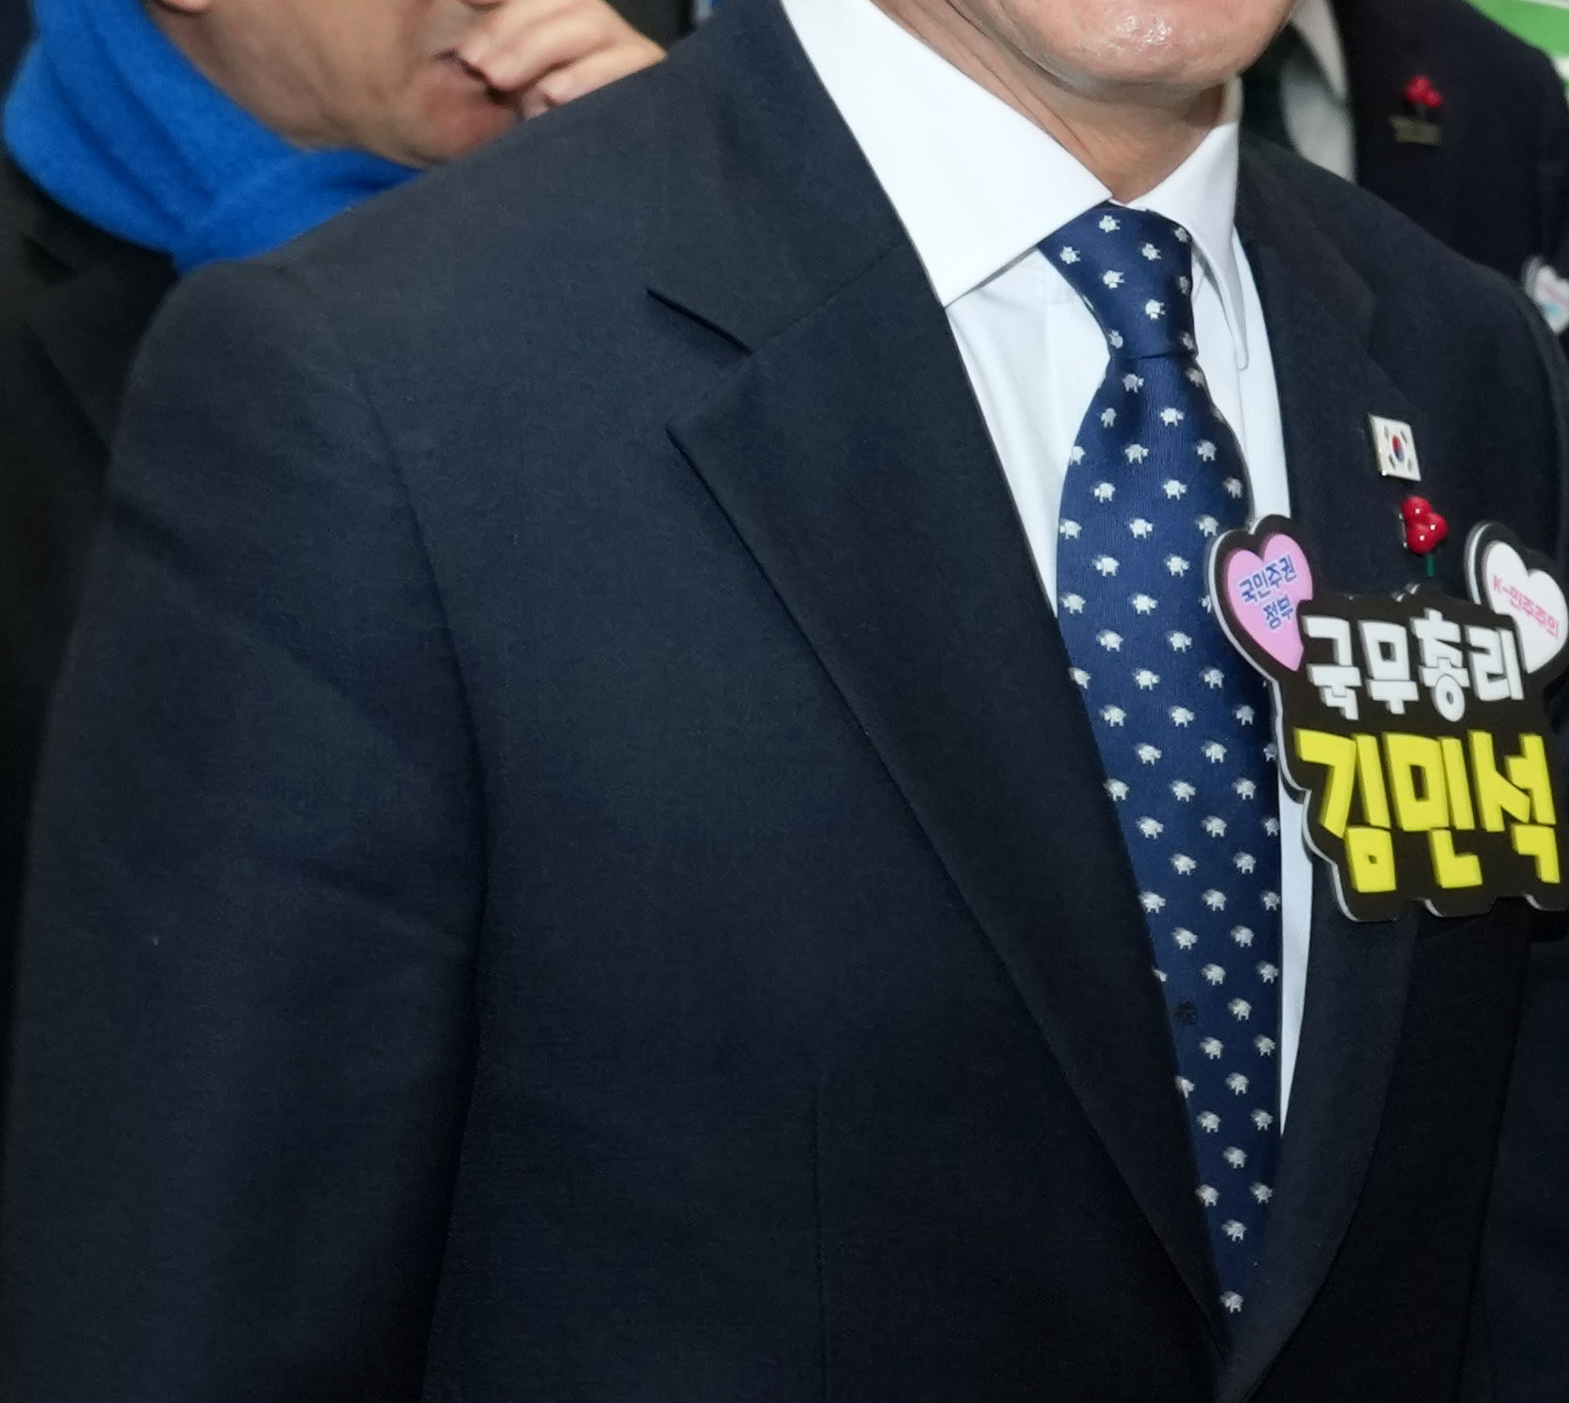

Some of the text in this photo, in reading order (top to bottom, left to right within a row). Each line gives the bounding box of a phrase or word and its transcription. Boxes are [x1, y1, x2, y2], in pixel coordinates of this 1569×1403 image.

[1239, 554, 1298, 603] 국민주권
[1263, 594, 1294, 630] 정부
[1300, 607, 1525, 723] 국무총리
[1293, 726, 1562, 894] 김민석
